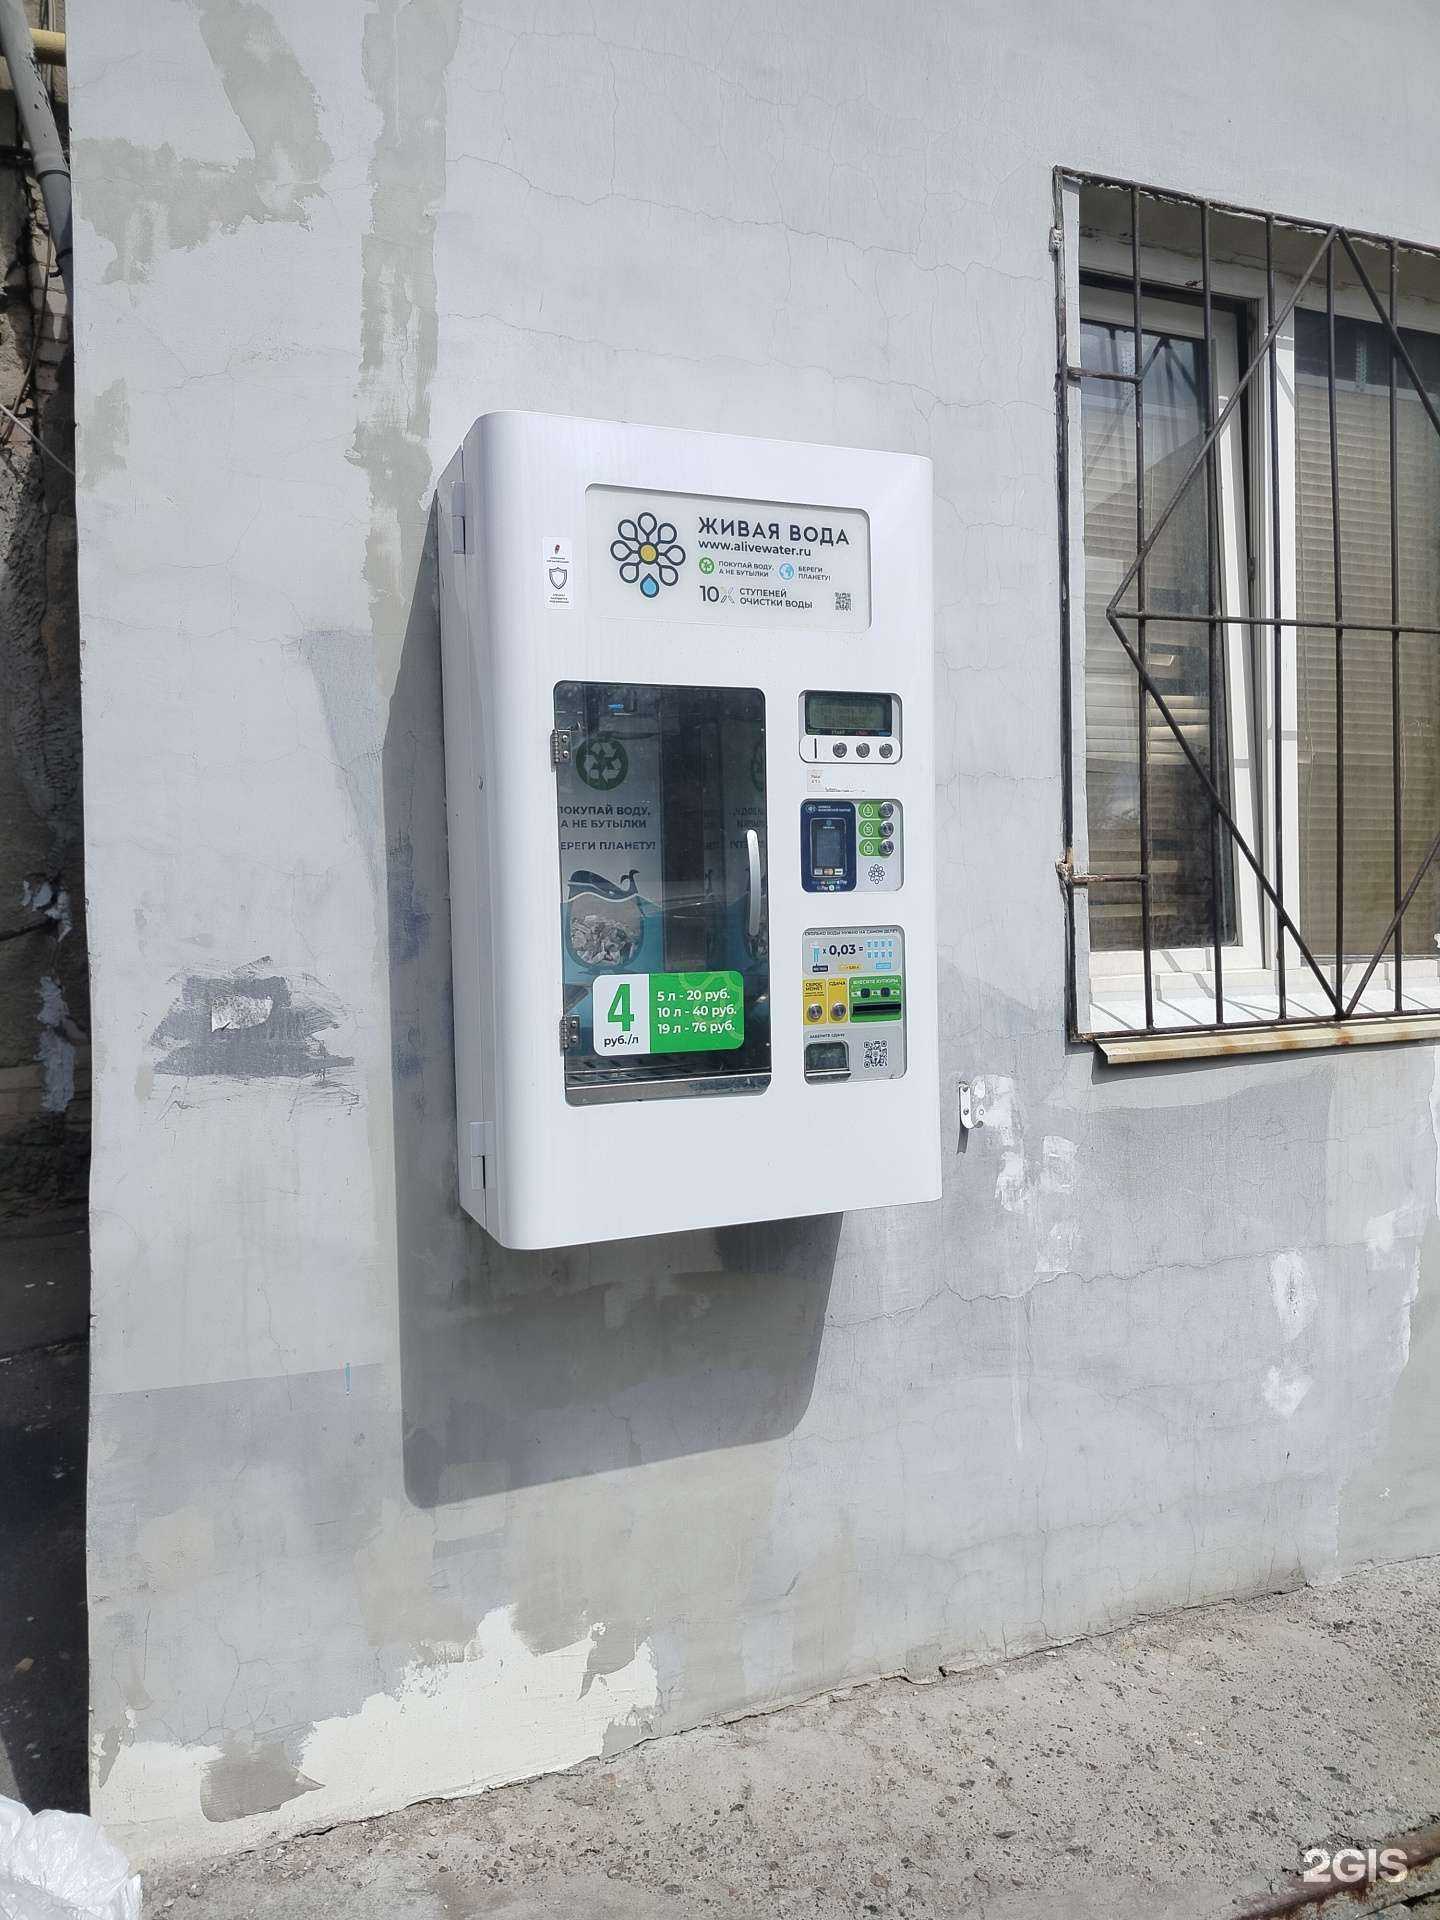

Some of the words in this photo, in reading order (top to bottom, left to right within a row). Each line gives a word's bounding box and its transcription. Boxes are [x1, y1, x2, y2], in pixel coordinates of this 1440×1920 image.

[698, 516, 780, 540] ЖИВАЯ
[789, 524, 850, 546] ВОДА
[698, 540, 811, 556] www.alivewater.ru
[718, 560, 752, 569] ПОКУПАЙ
[753, 562, 775, 571] ВОДУ,
[736, 570, 769, 578] БУТЫЛКИ
[739, 587, 787, 598] СТУПЕНЕЙ
[739, 597, 783, 607] ОЧИСТКИ
[785, 599, 813, 609] ВОДЫ
[616, 806, 651, 816] ВОДУ,
[561, 820, 568, 828] А
[573, 820, 588, 828] НЕ
[591, 820, 647, 829] БУТЫЛКИ
[560, 841, 596, 850] ЕРЕГИ
[599, 841, 656, 850] ПЛАНЕТУ!
[829, 944, 856, 957] 0,03
[657, 991, 665, 1001] 5
[667, 993, 676, 1001] л
[686, 990, 702, 1001] 20
[705, 988, 731, 1002] руб.
[607, 983, 635, 1032] 4
[657, 1007, 670, 1018] 10
[673, 1009, 682, 1017] л
[692, 1006, 708, 1016] 40
[711, 1004, 737, 1018] руб.
[657, 1023, 670, 1034] 19
[673, 1025, 682, 1033] л
[692, 1022, 707, 1032] 76
[710, 1021, 736, 1034] руб.
[604, 1034, 639, 1047] руб./л
